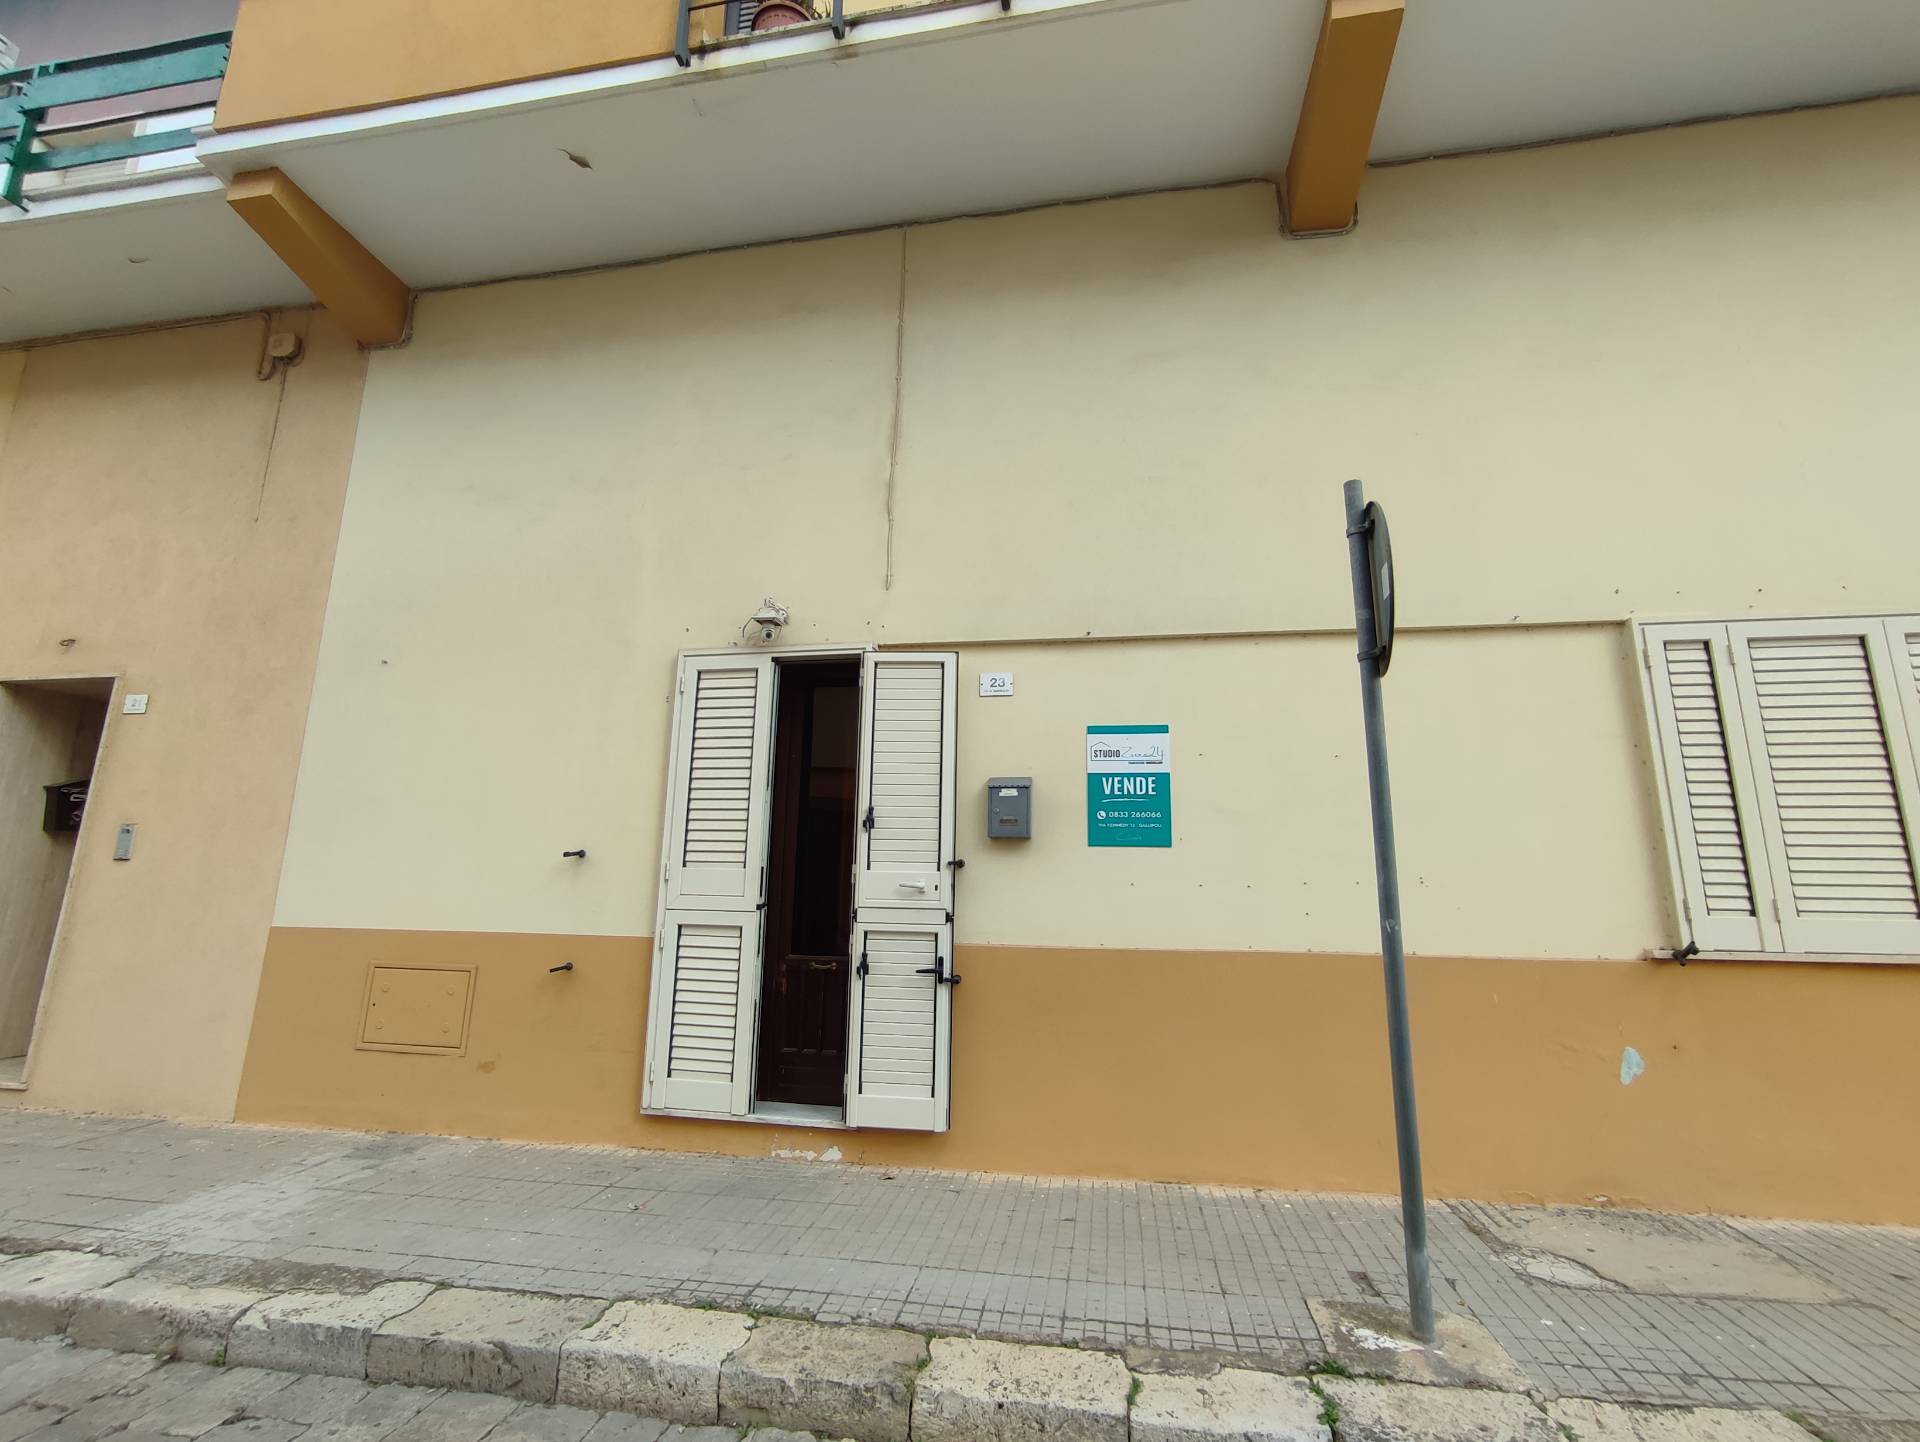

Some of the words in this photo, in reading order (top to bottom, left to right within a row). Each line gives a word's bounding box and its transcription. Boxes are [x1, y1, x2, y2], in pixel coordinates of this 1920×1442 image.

[990, 677, 1006, 688] 23
[1093, 749, 1121, 758] STUDIO
[1101, 776, 1157, 795] VENDE
